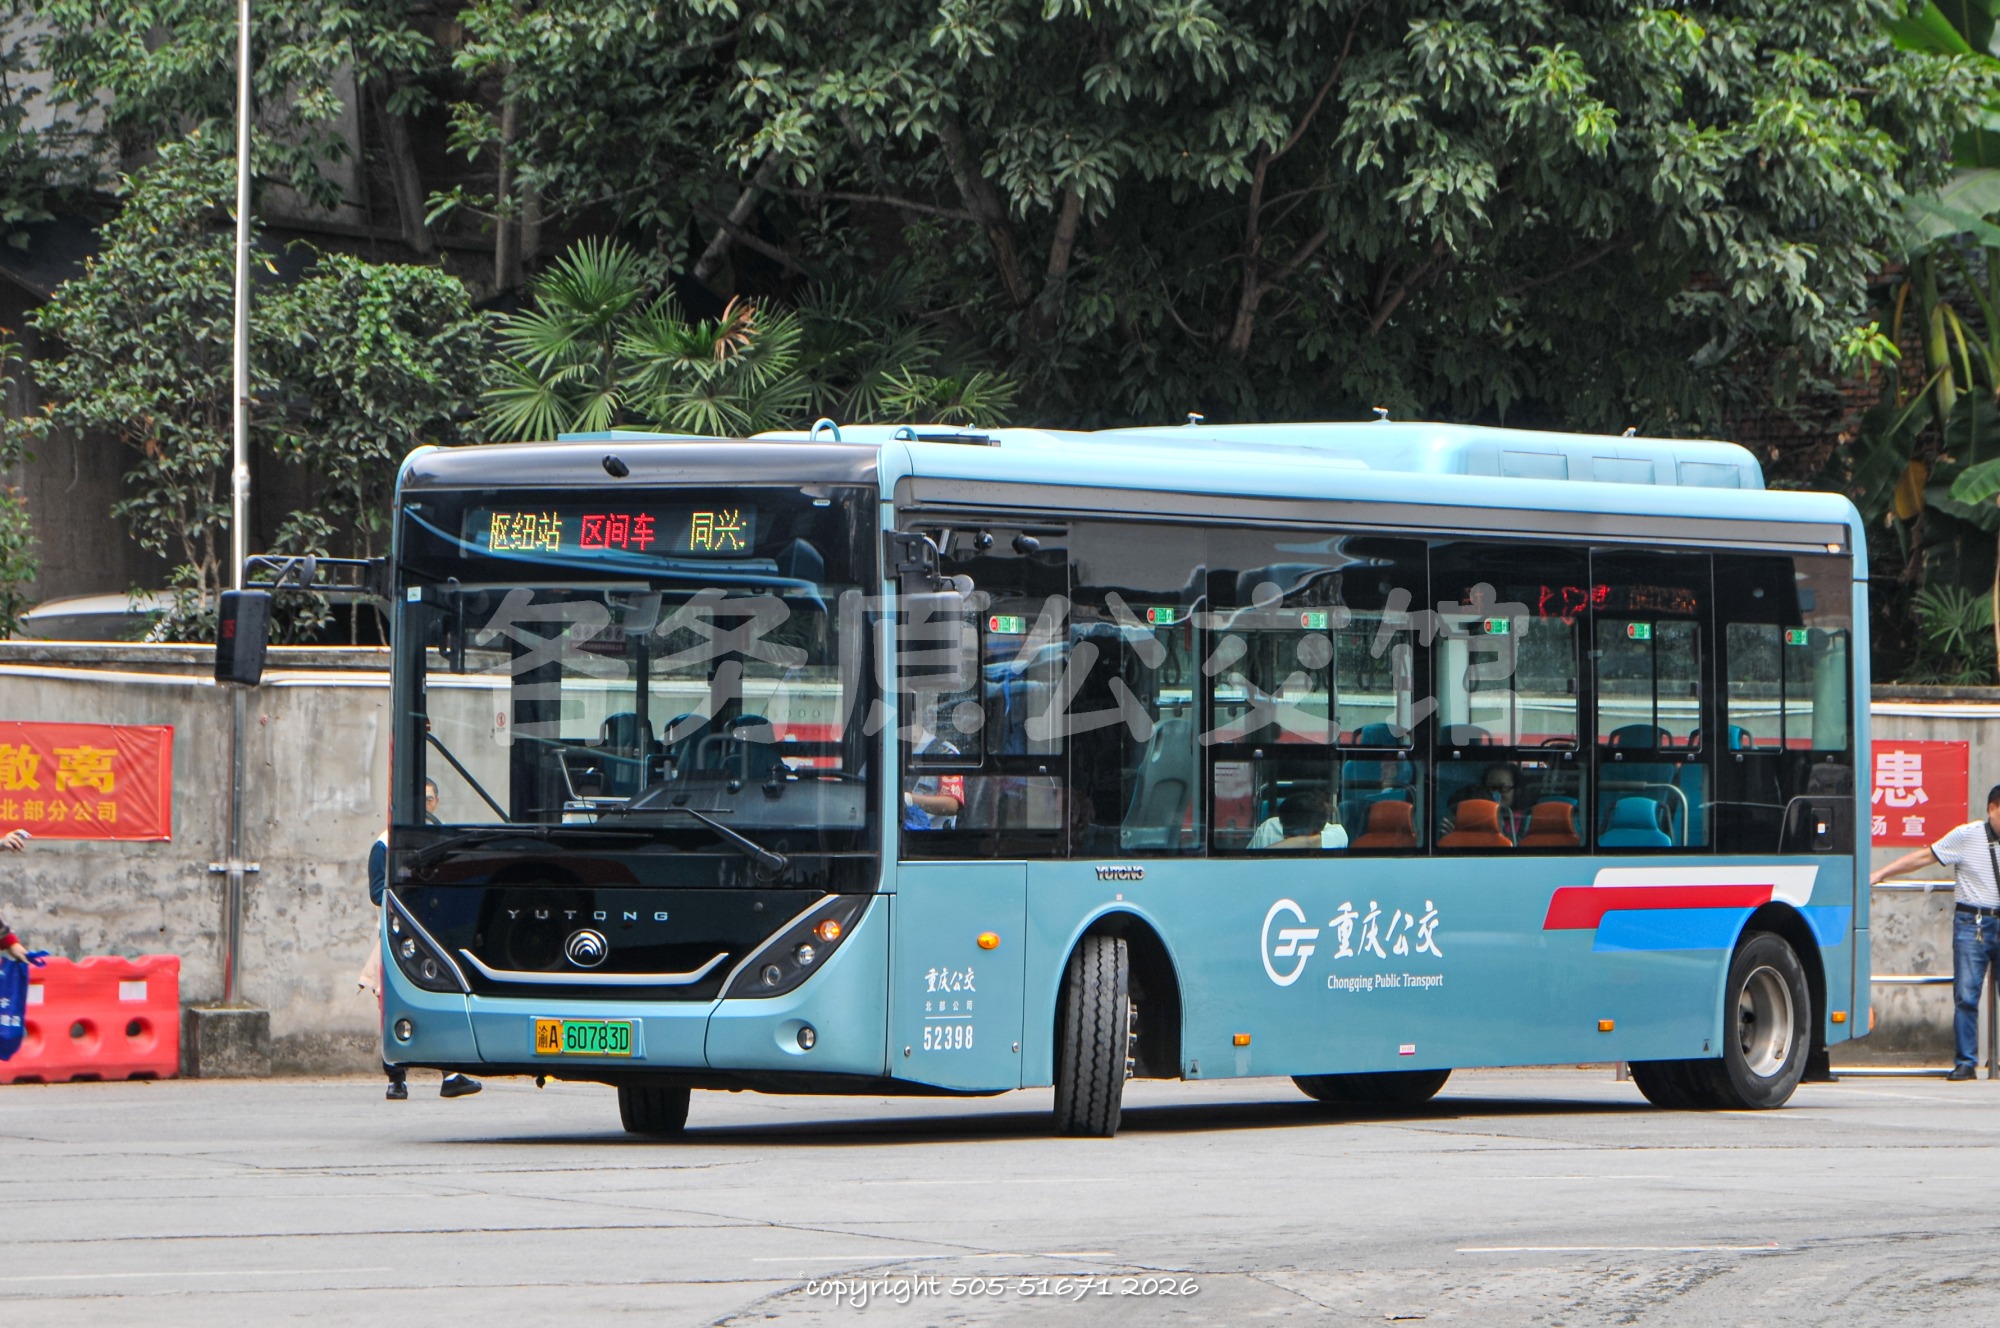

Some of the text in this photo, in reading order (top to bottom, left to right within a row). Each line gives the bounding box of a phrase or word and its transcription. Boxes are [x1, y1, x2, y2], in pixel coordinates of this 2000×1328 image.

[580, 512, 656, 551] 区间车
[690, 509, 747, 551] 同兴
[1871, 750, 1929, 807] 患
[507, 909, 669, 921] YUTONG
[1328, 900, 1443, 959] 重庆公交
[924, 967, 976, 992] 重庆公交
[1328, 973, 1443, 992] Chongqing Public Transport
[923, 1025, 973, 1051] 52398
